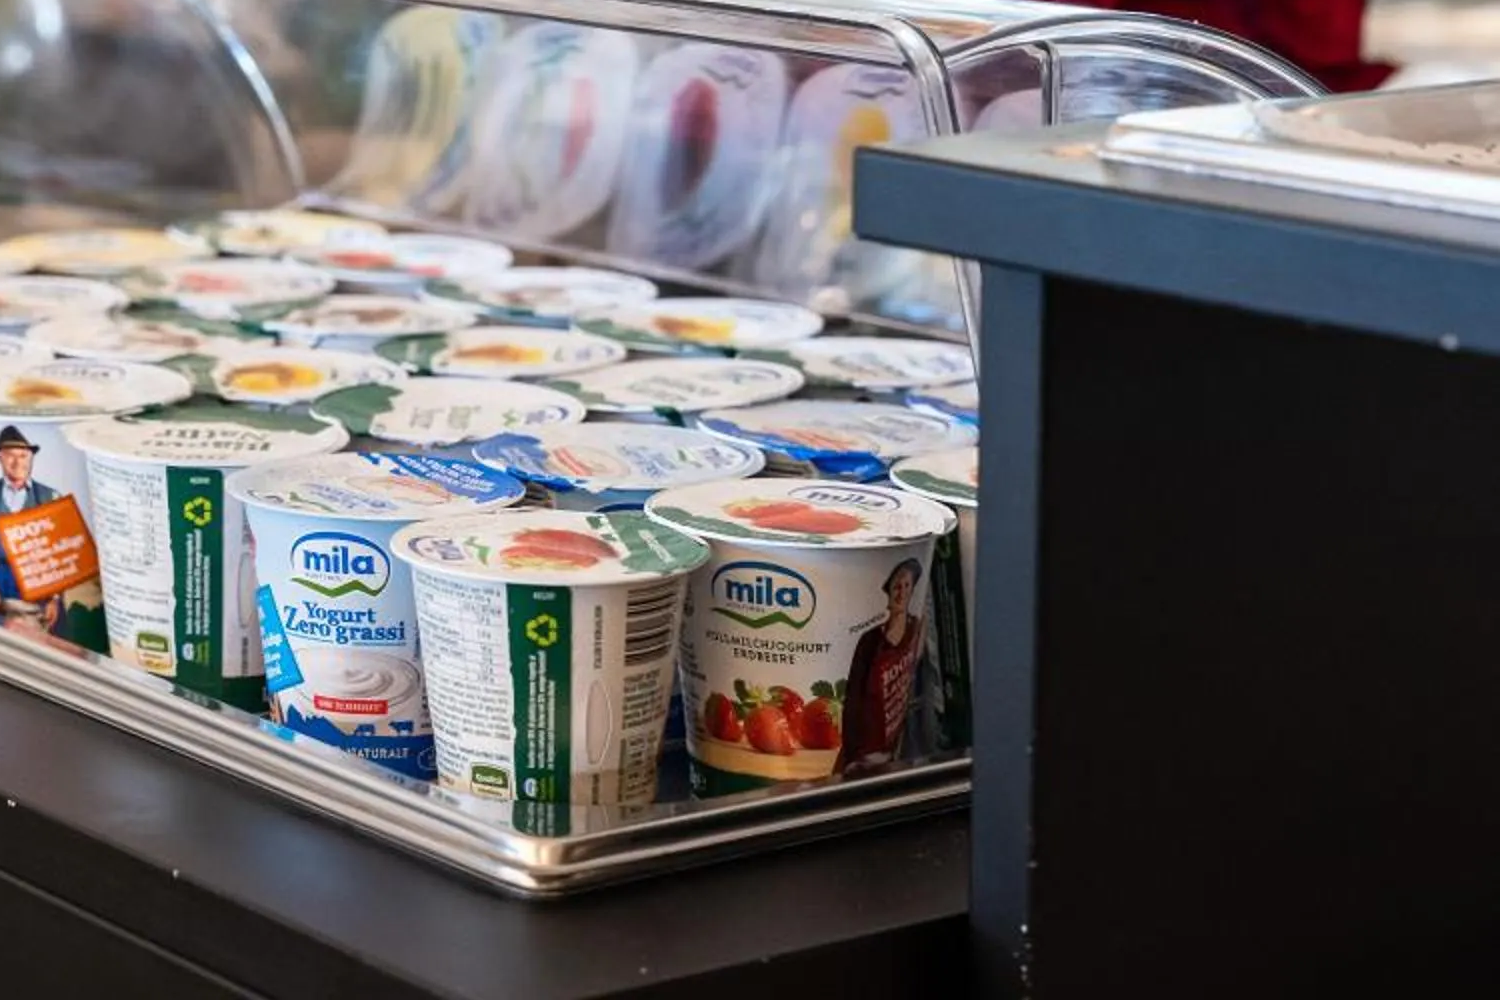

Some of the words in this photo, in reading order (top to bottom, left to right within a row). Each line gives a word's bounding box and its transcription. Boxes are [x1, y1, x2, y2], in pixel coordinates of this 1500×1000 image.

[3, 516, 56, 541] 100%
[303, 545, 376, 575] mila
[724, 575, 800, 608] mila
[283, 604, 332, 637] Zero
[335, 620, 405, 645] grassi
[302, 600, 377, 627] Yogurt
[733, 647, 797, 665] ERDBEERE
